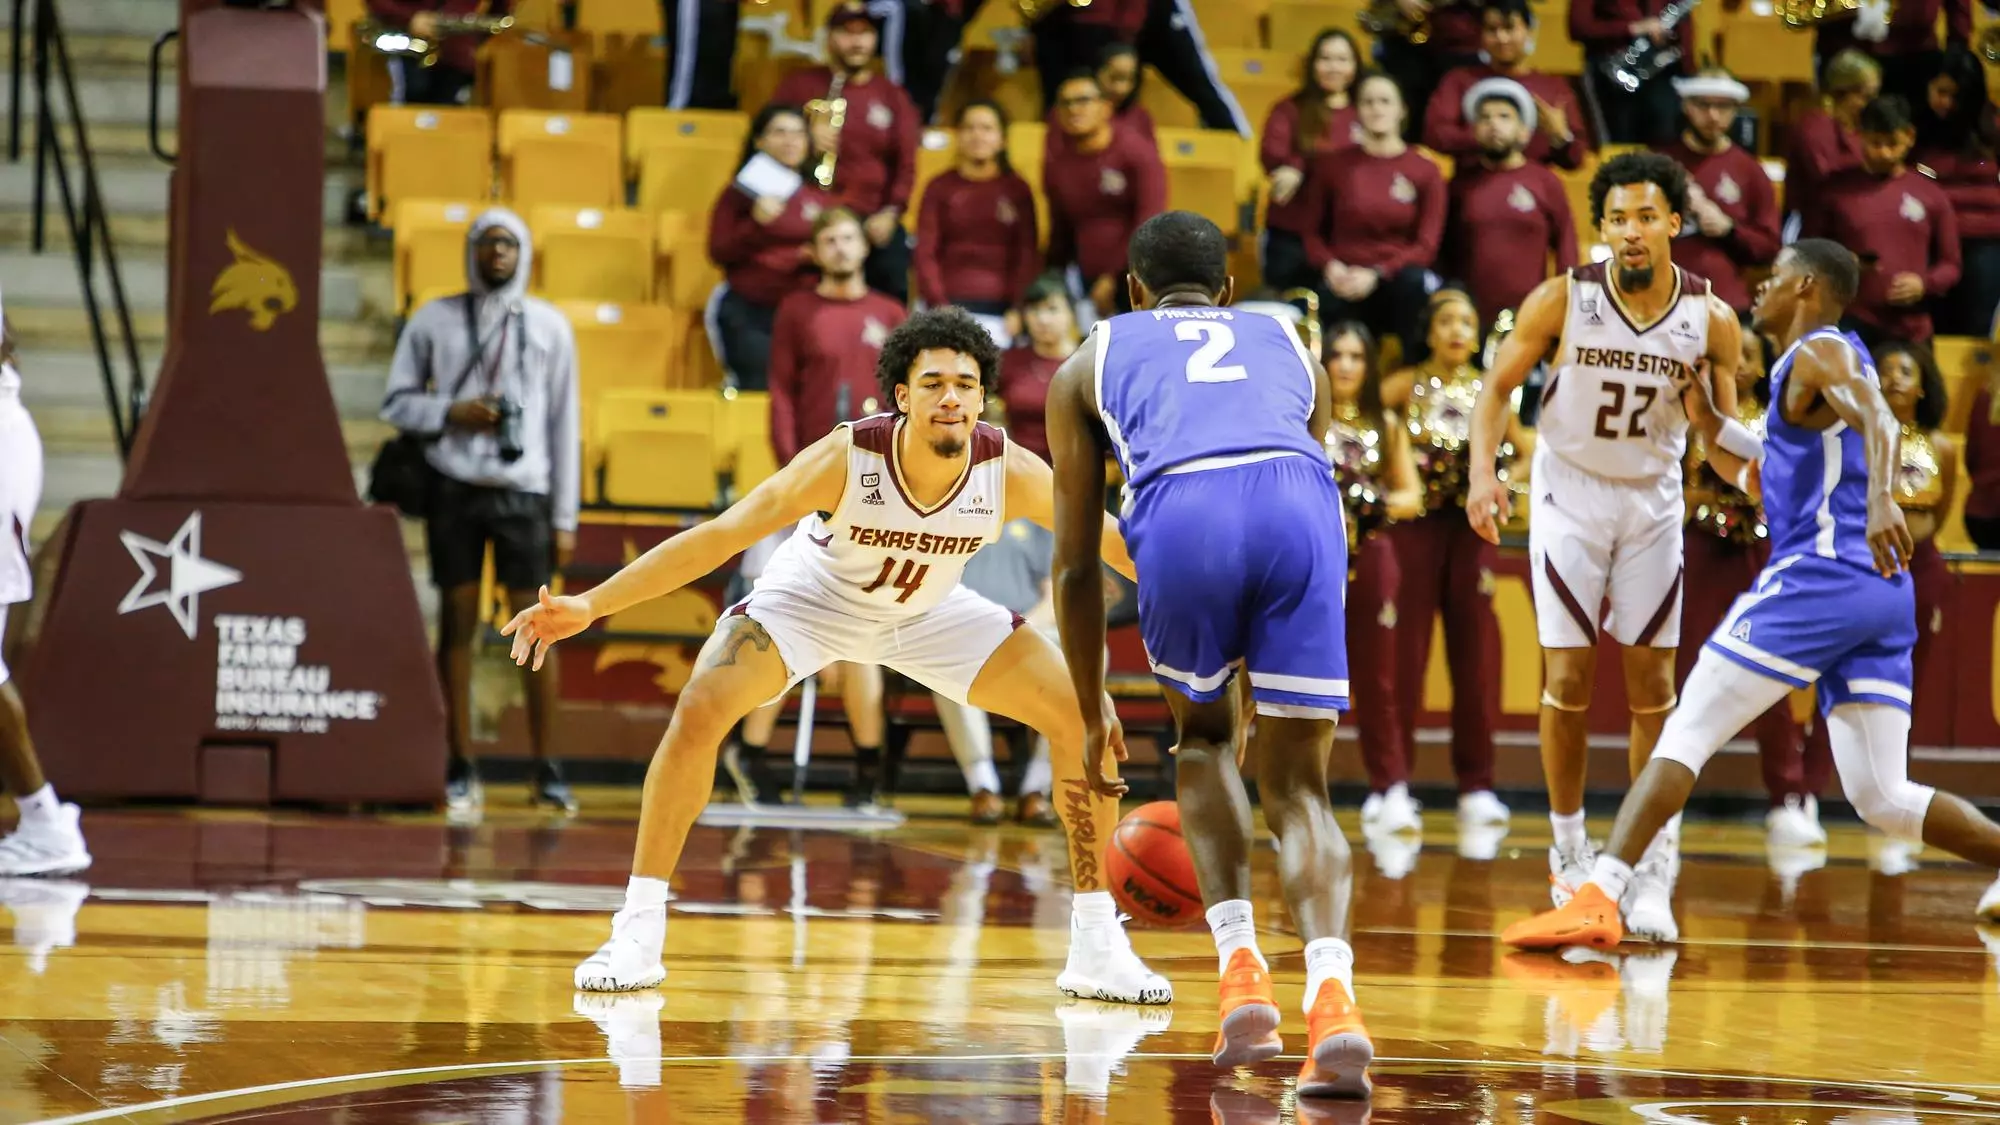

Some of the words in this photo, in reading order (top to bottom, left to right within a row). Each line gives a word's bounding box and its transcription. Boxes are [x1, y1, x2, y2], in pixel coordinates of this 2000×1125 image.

[1151, 309, 1234, 321] PHILLIPS
[1174, 320, 1248, 383] 2
[1576, 347, 1635, 370] TEXAS
[1594, 382, 1658, 439] 22
[861, 498, 885, 506] adidas
[850, 525, 918, 551] TEXAS
[917, 533, 983, 555] STATE
[861, 556, 929, 604] 14
[214, 614, 306, 645] TEXAS
[218, 644, 297, 669] FARM
[217, 666, 331, 694] BUREAU
[216, 690, 379, 720] INSURANCE
